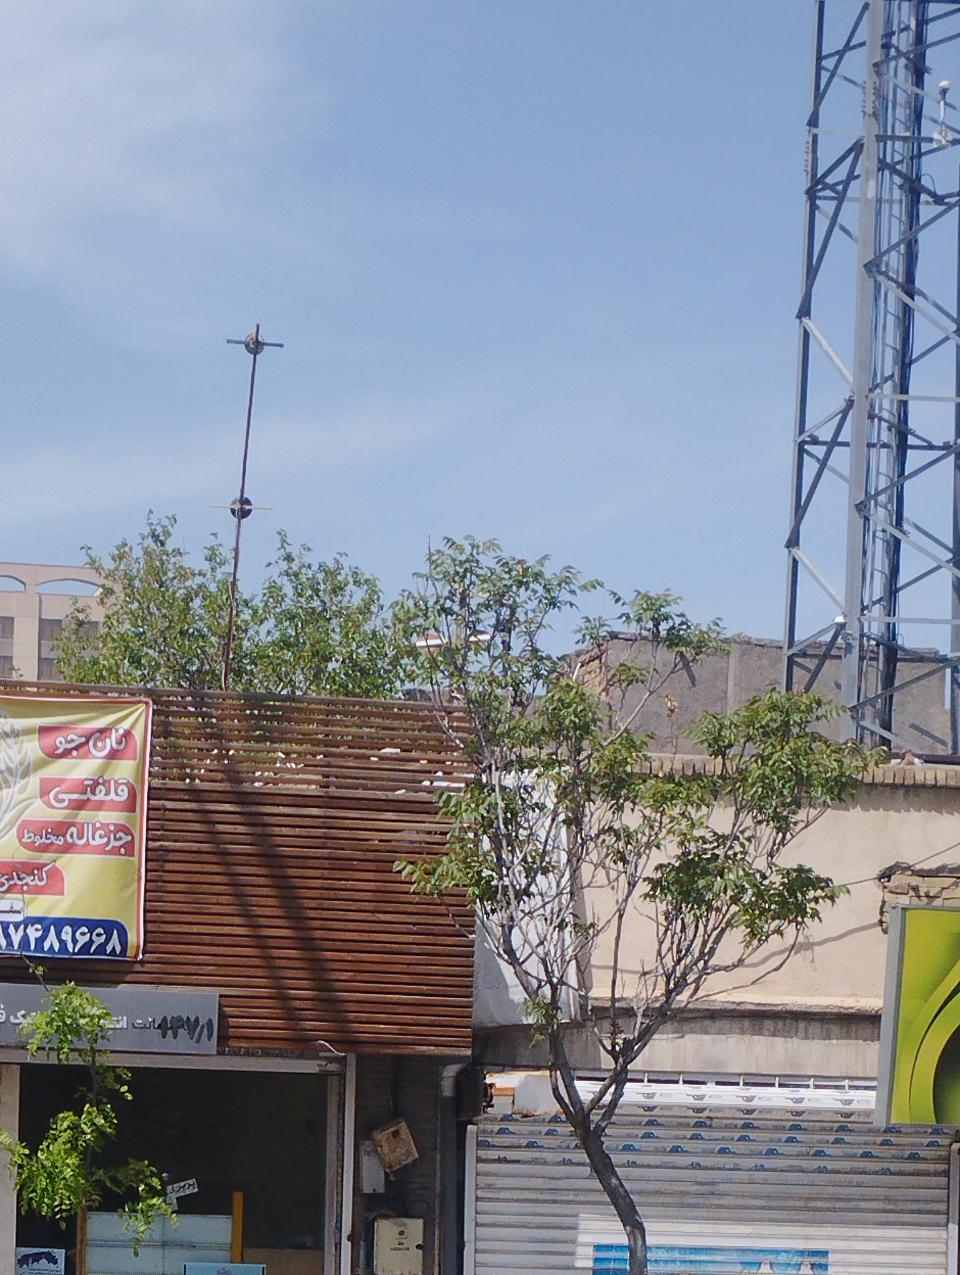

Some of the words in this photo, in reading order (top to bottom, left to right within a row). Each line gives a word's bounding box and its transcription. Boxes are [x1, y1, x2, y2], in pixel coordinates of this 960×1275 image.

[55, 733, 86, 755] جو
[89, 728, 127, 757] نان
[48, 776, 129, 808] قلفتی
[22, 827, 64, 846] مخلوط
[66, 821, 131, 855] جزغاله
